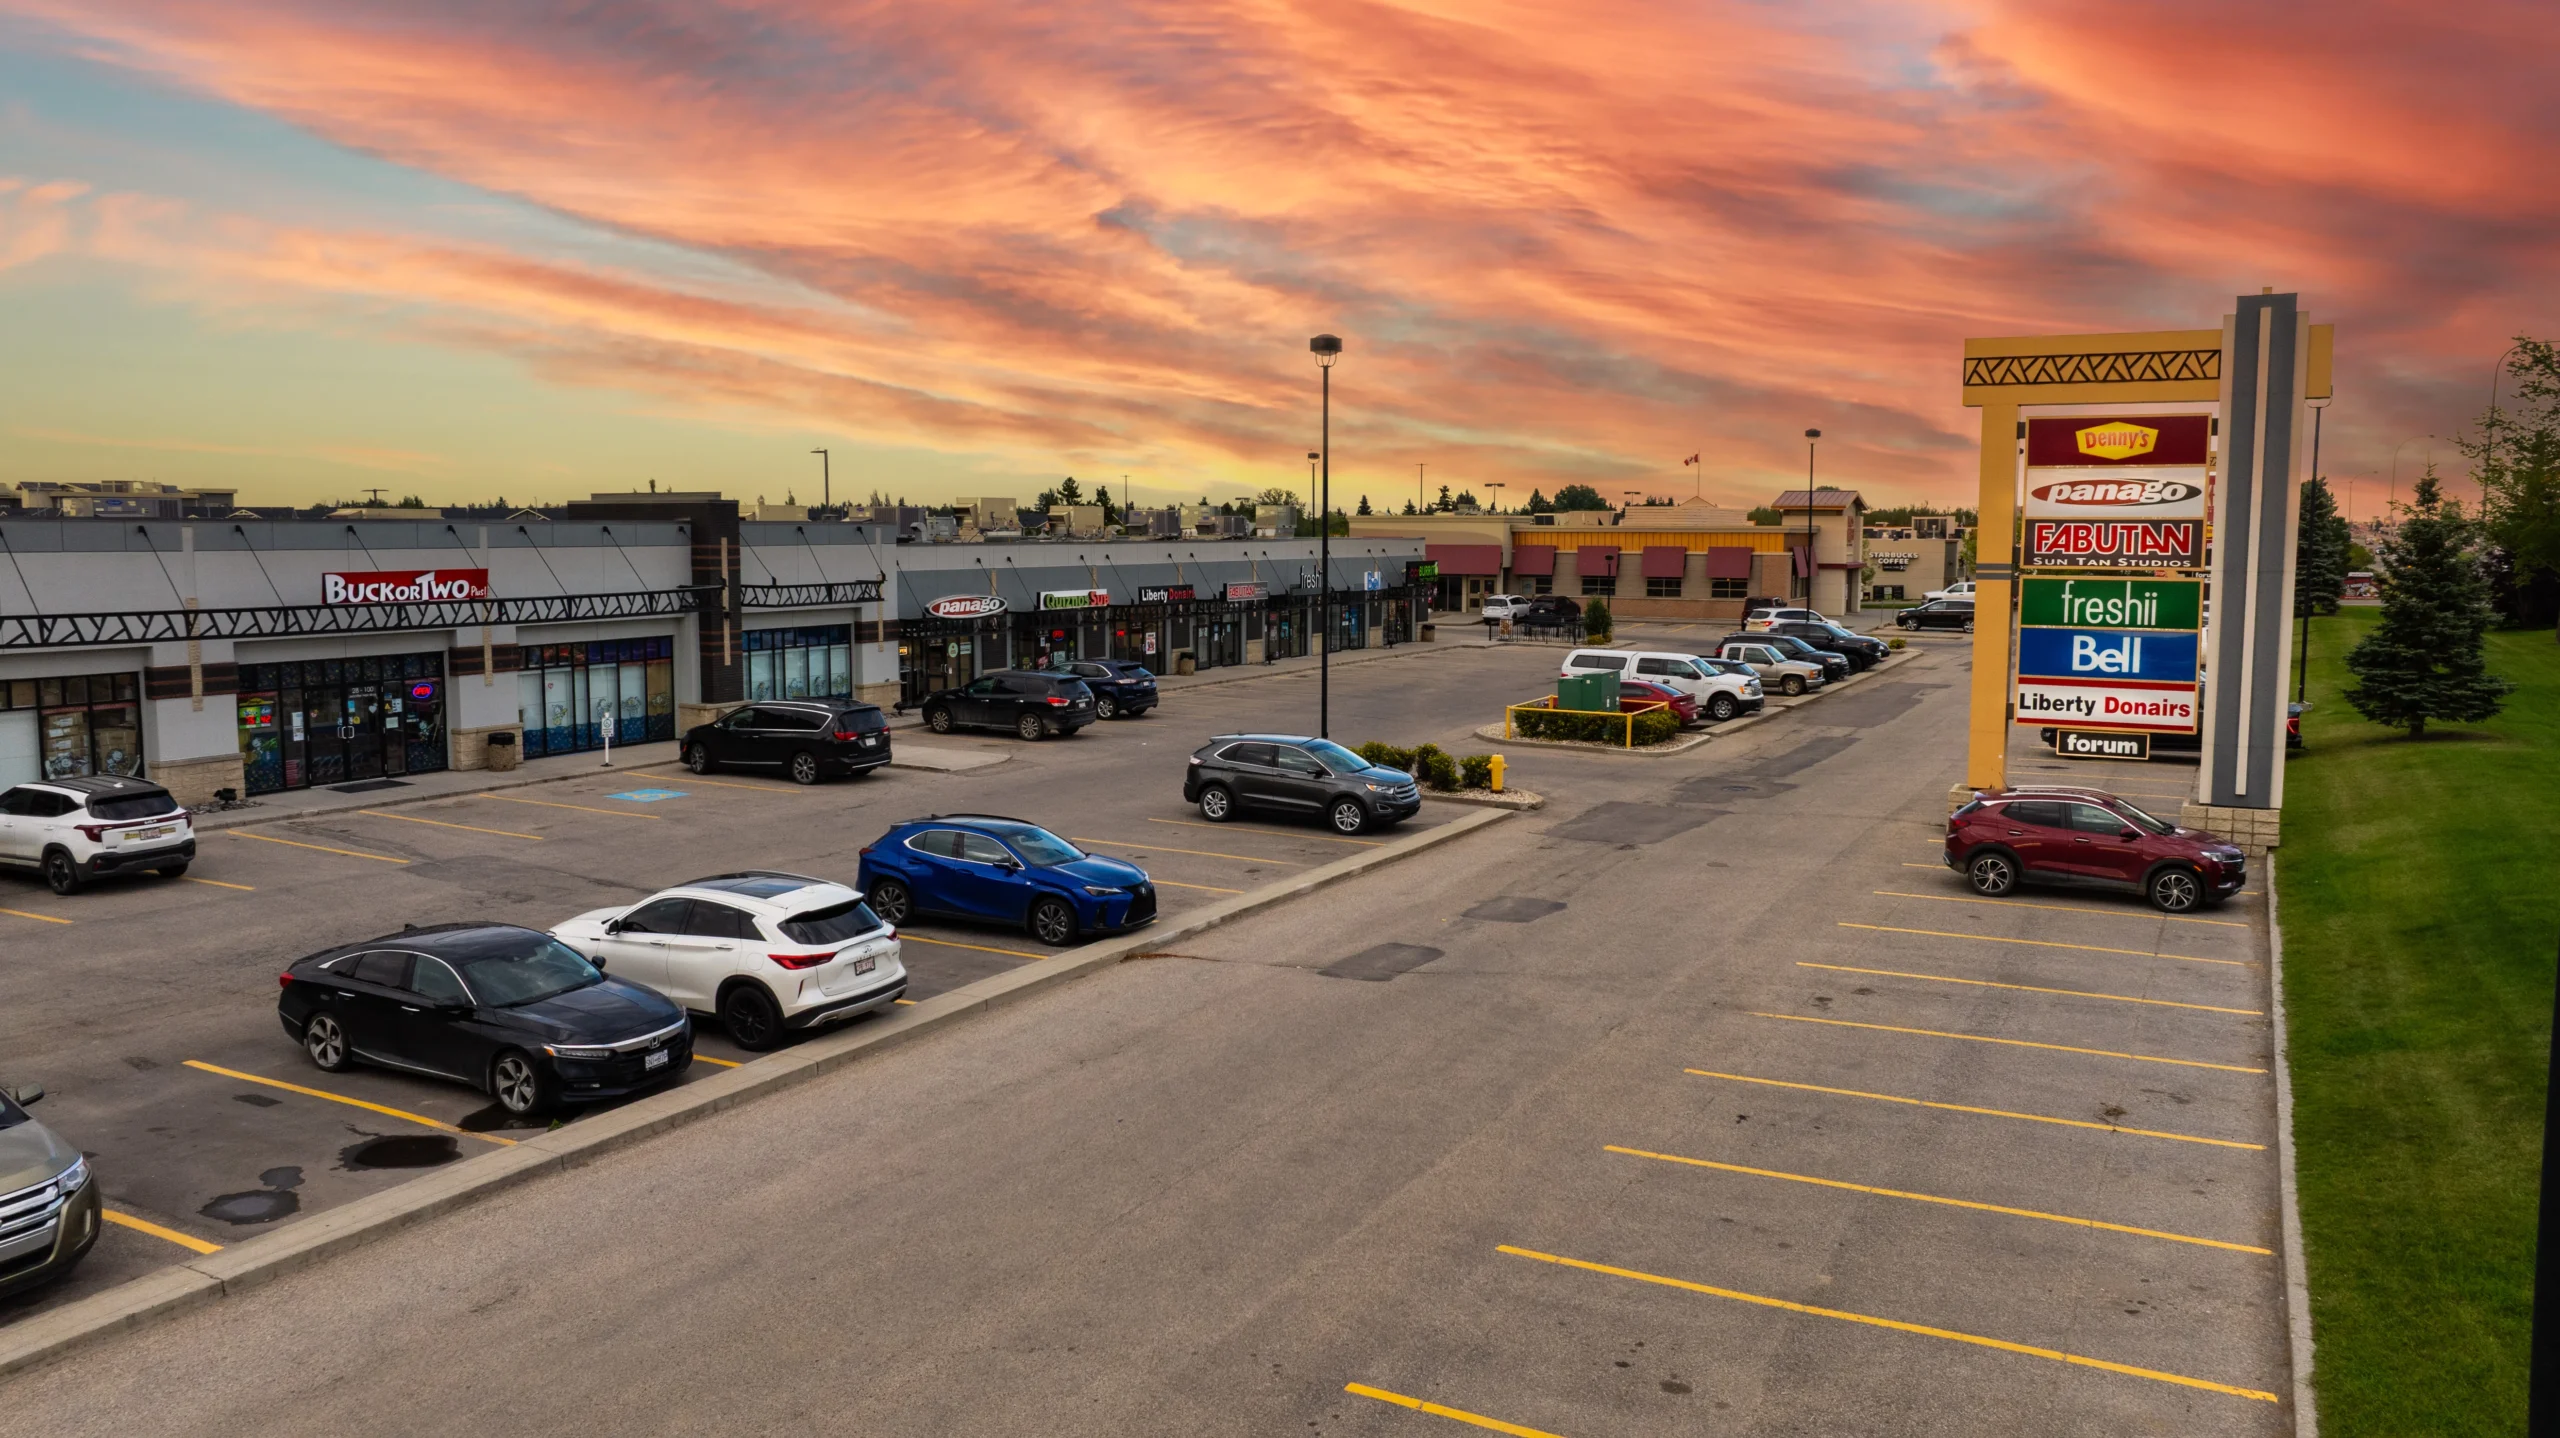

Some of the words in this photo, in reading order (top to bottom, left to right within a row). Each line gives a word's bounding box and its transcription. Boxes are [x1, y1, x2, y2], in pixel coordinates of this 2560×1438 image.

[2084, 429, 2149, 449] Denny's
[2049, 479, 2187, 504] panago
[2034, 523, 2192, 556] FABUTAN
[2033, 557, 2068, 566] SUN
[2076, 557, 2111, 567] TAN
[2117, 558, 2191, 568] STUDIOS
[1301, 565, 1323, 589] freshi
[939, 597, 1000, 615] panago
[1141, 589, 1168, 603] Liberty
[1168, 587, 1196, 600] Donairs
[2061, 581, 2157, 626] freshii
[2071, 635, 2141, 673] Bell
[2019, 693, 2096, 717] Liberty
[2104, 696, 2190, 718] Donairs
[2067, 733, 2138, 755] forum
